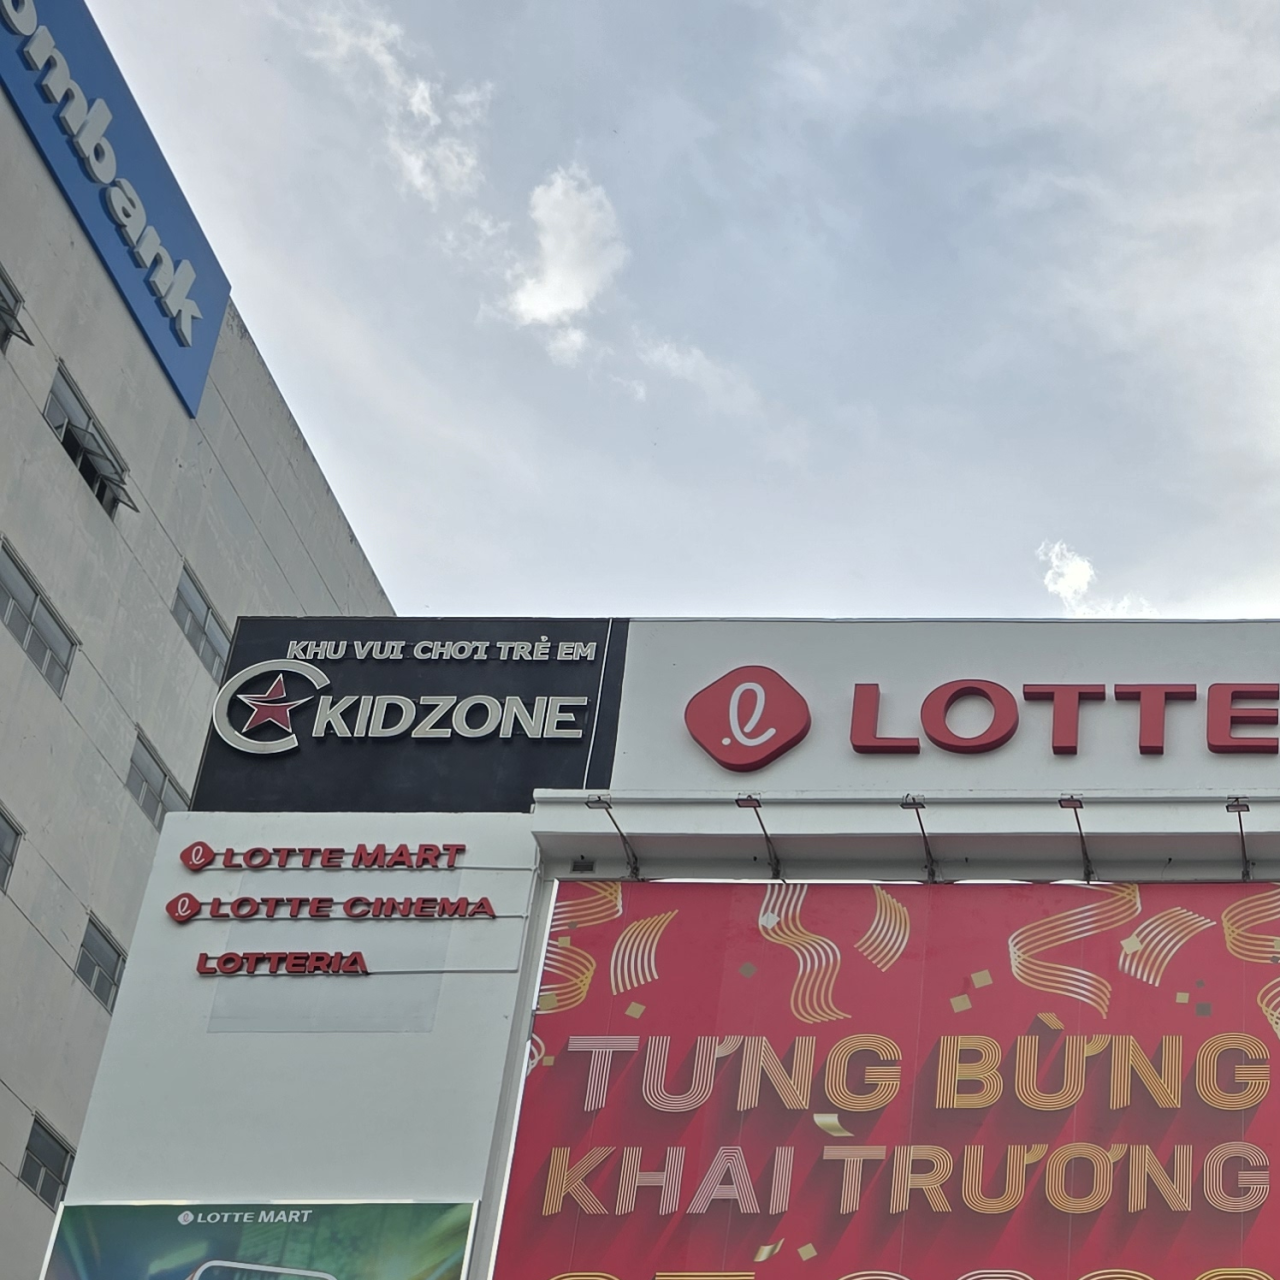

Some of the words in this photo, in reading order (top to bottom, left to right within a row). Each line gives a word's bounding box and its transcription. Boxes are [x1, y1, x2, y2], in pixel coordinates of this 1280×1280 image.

[287, 641, 346, 660] KHU
[354, 641, 406, 660] VUI
[413, 640, 489, 660] CHƠI
[497, 636, 550, 661] TRẺ
[557, 641, 596, 661] EM
[312, 695, 588, 738] KIDZONE
[850, 679, 1280, 754] LOTTE
[222, 847, 345, 868] LOTTE
[351, 844, 466, 869] MART
[208, 897, 334, 917] LOTTE
[342, 897, 496, 918] CINEMA
[196, 951, 368, 974] LOTTERIA
[567, 1034, 902, 1112] TƯNG
[935, 1012, 1270, 1111] BỪNG
[542, 1145, 795, 1216] KHAI
[823, 1141, 1270, 1215] TRƯƠNG
[196, 1211, 255, 1223] LOTTE
[258, 1209, 312, 1223] MART
